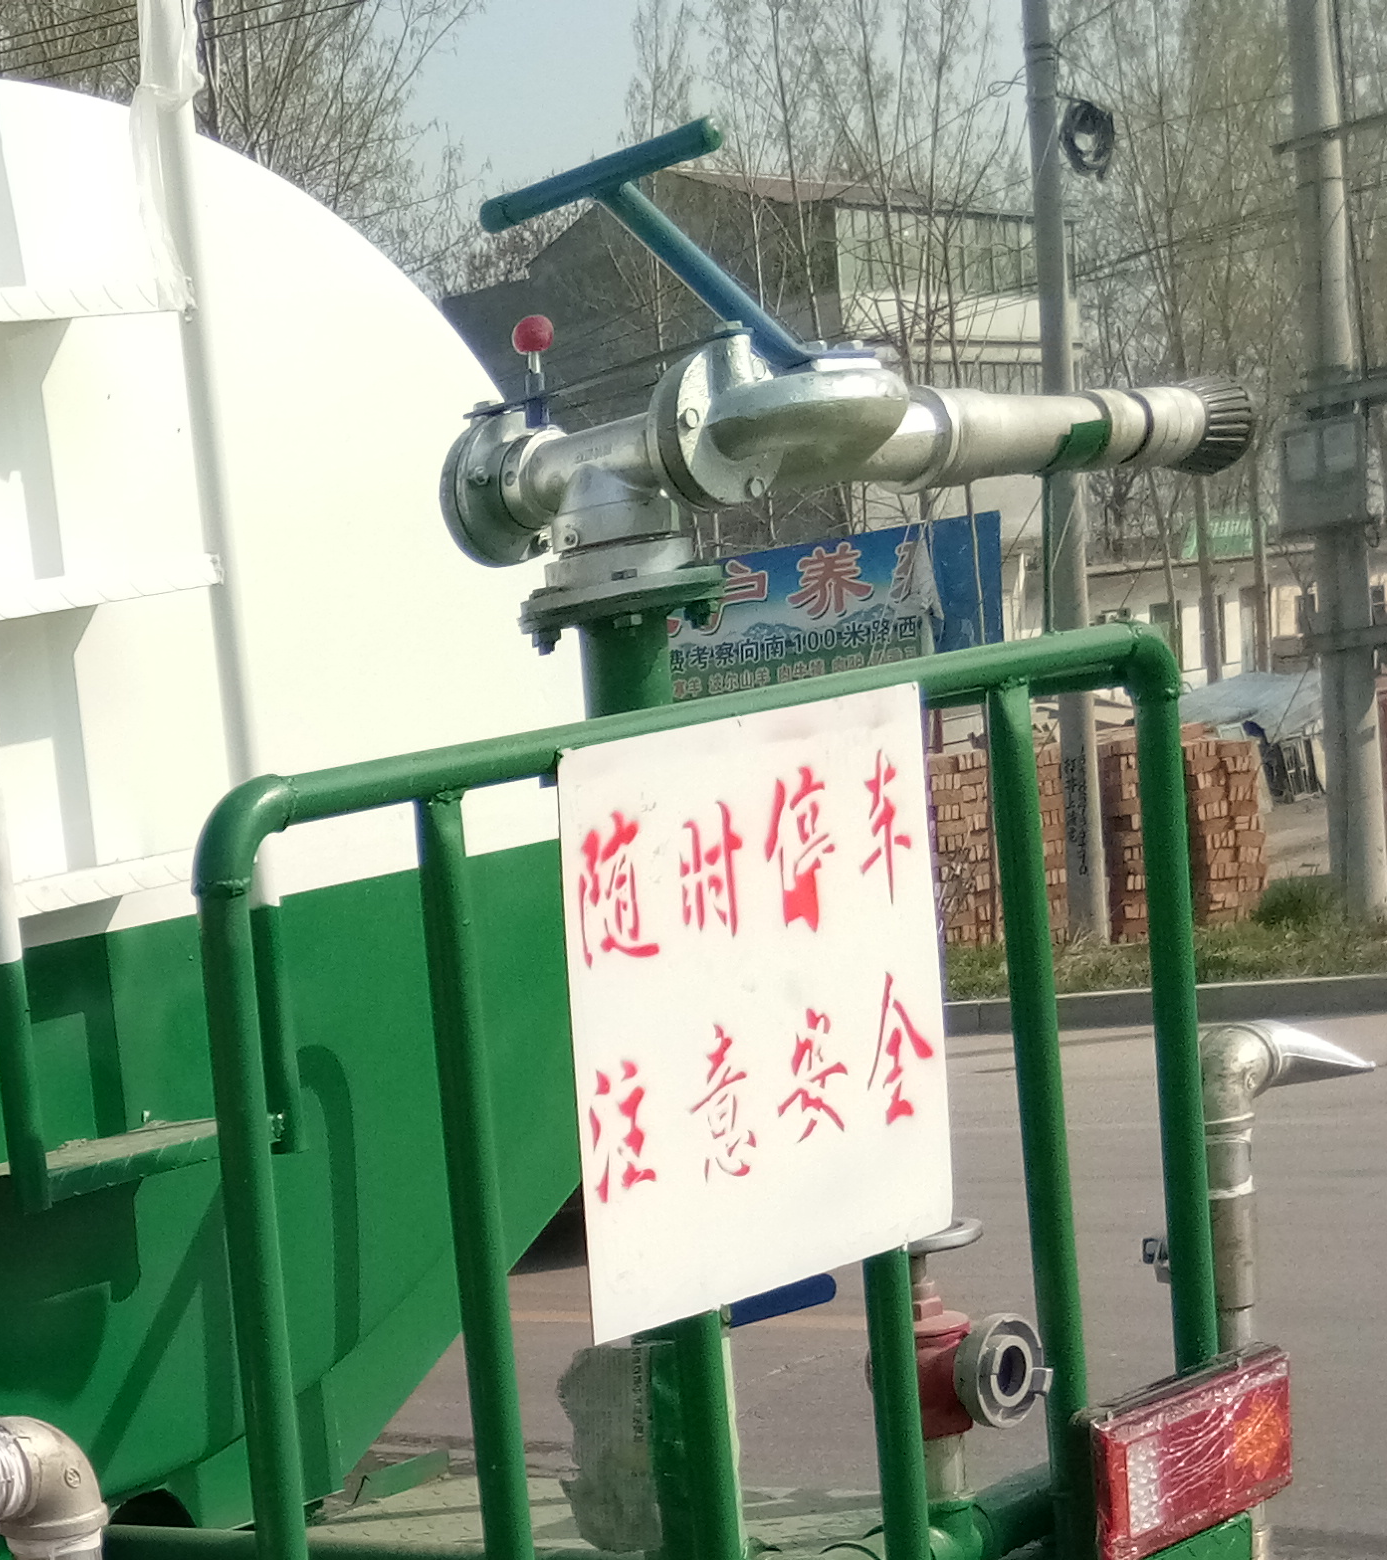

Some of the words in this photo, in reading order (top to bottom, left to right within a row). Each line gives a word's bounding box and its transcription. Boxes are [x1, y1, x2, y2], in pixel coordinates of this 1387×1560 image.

[579, 749, 912, 968] 随时停车
[588, 971, 933, 1203] 注意安全
